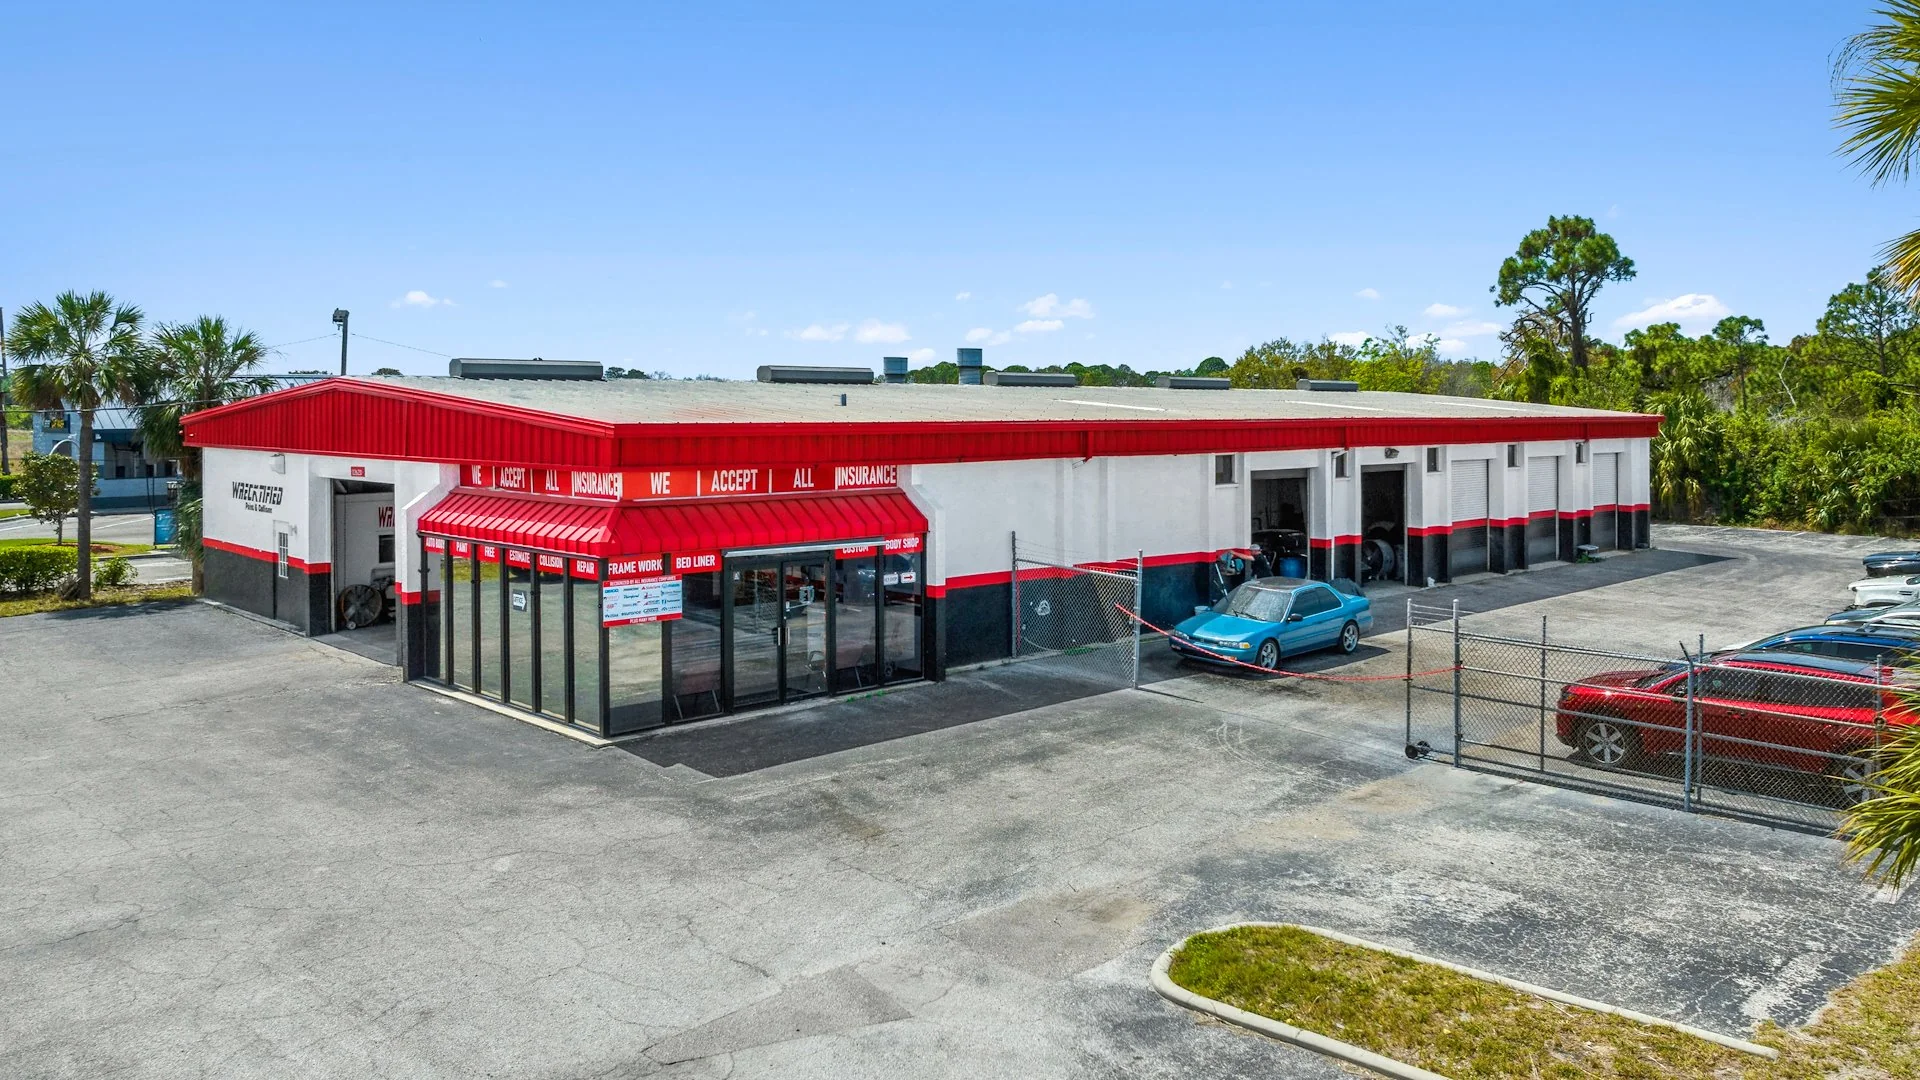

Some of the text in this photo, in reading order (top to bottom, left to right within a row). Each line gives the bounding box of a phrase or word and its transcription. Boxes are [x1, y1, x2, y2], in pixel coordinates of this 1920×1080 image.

[471, 465, 619, 495] WE ACCEPT ALL INSURANCE
[650, 465, 897, 495] WE ACCEPT ALL INSURANCE
[232, 481, 283, 506] WRECKTIFIED
[426, 537, 435, 548] AUTO
[456, 541, 468, 553] PAINT
[885, 537, 919, 550] BODY SHOP
[484, 546, 495, 558] FREE
[509, 550, 531, 564] ESTIMATE
[539, 554, 563, 569] COLLISION
[576, 560, 595, 574] REPAIR
[608, 559, 663, 575] FRAME WORK
[676, 554, 715, 569] BED LINER
